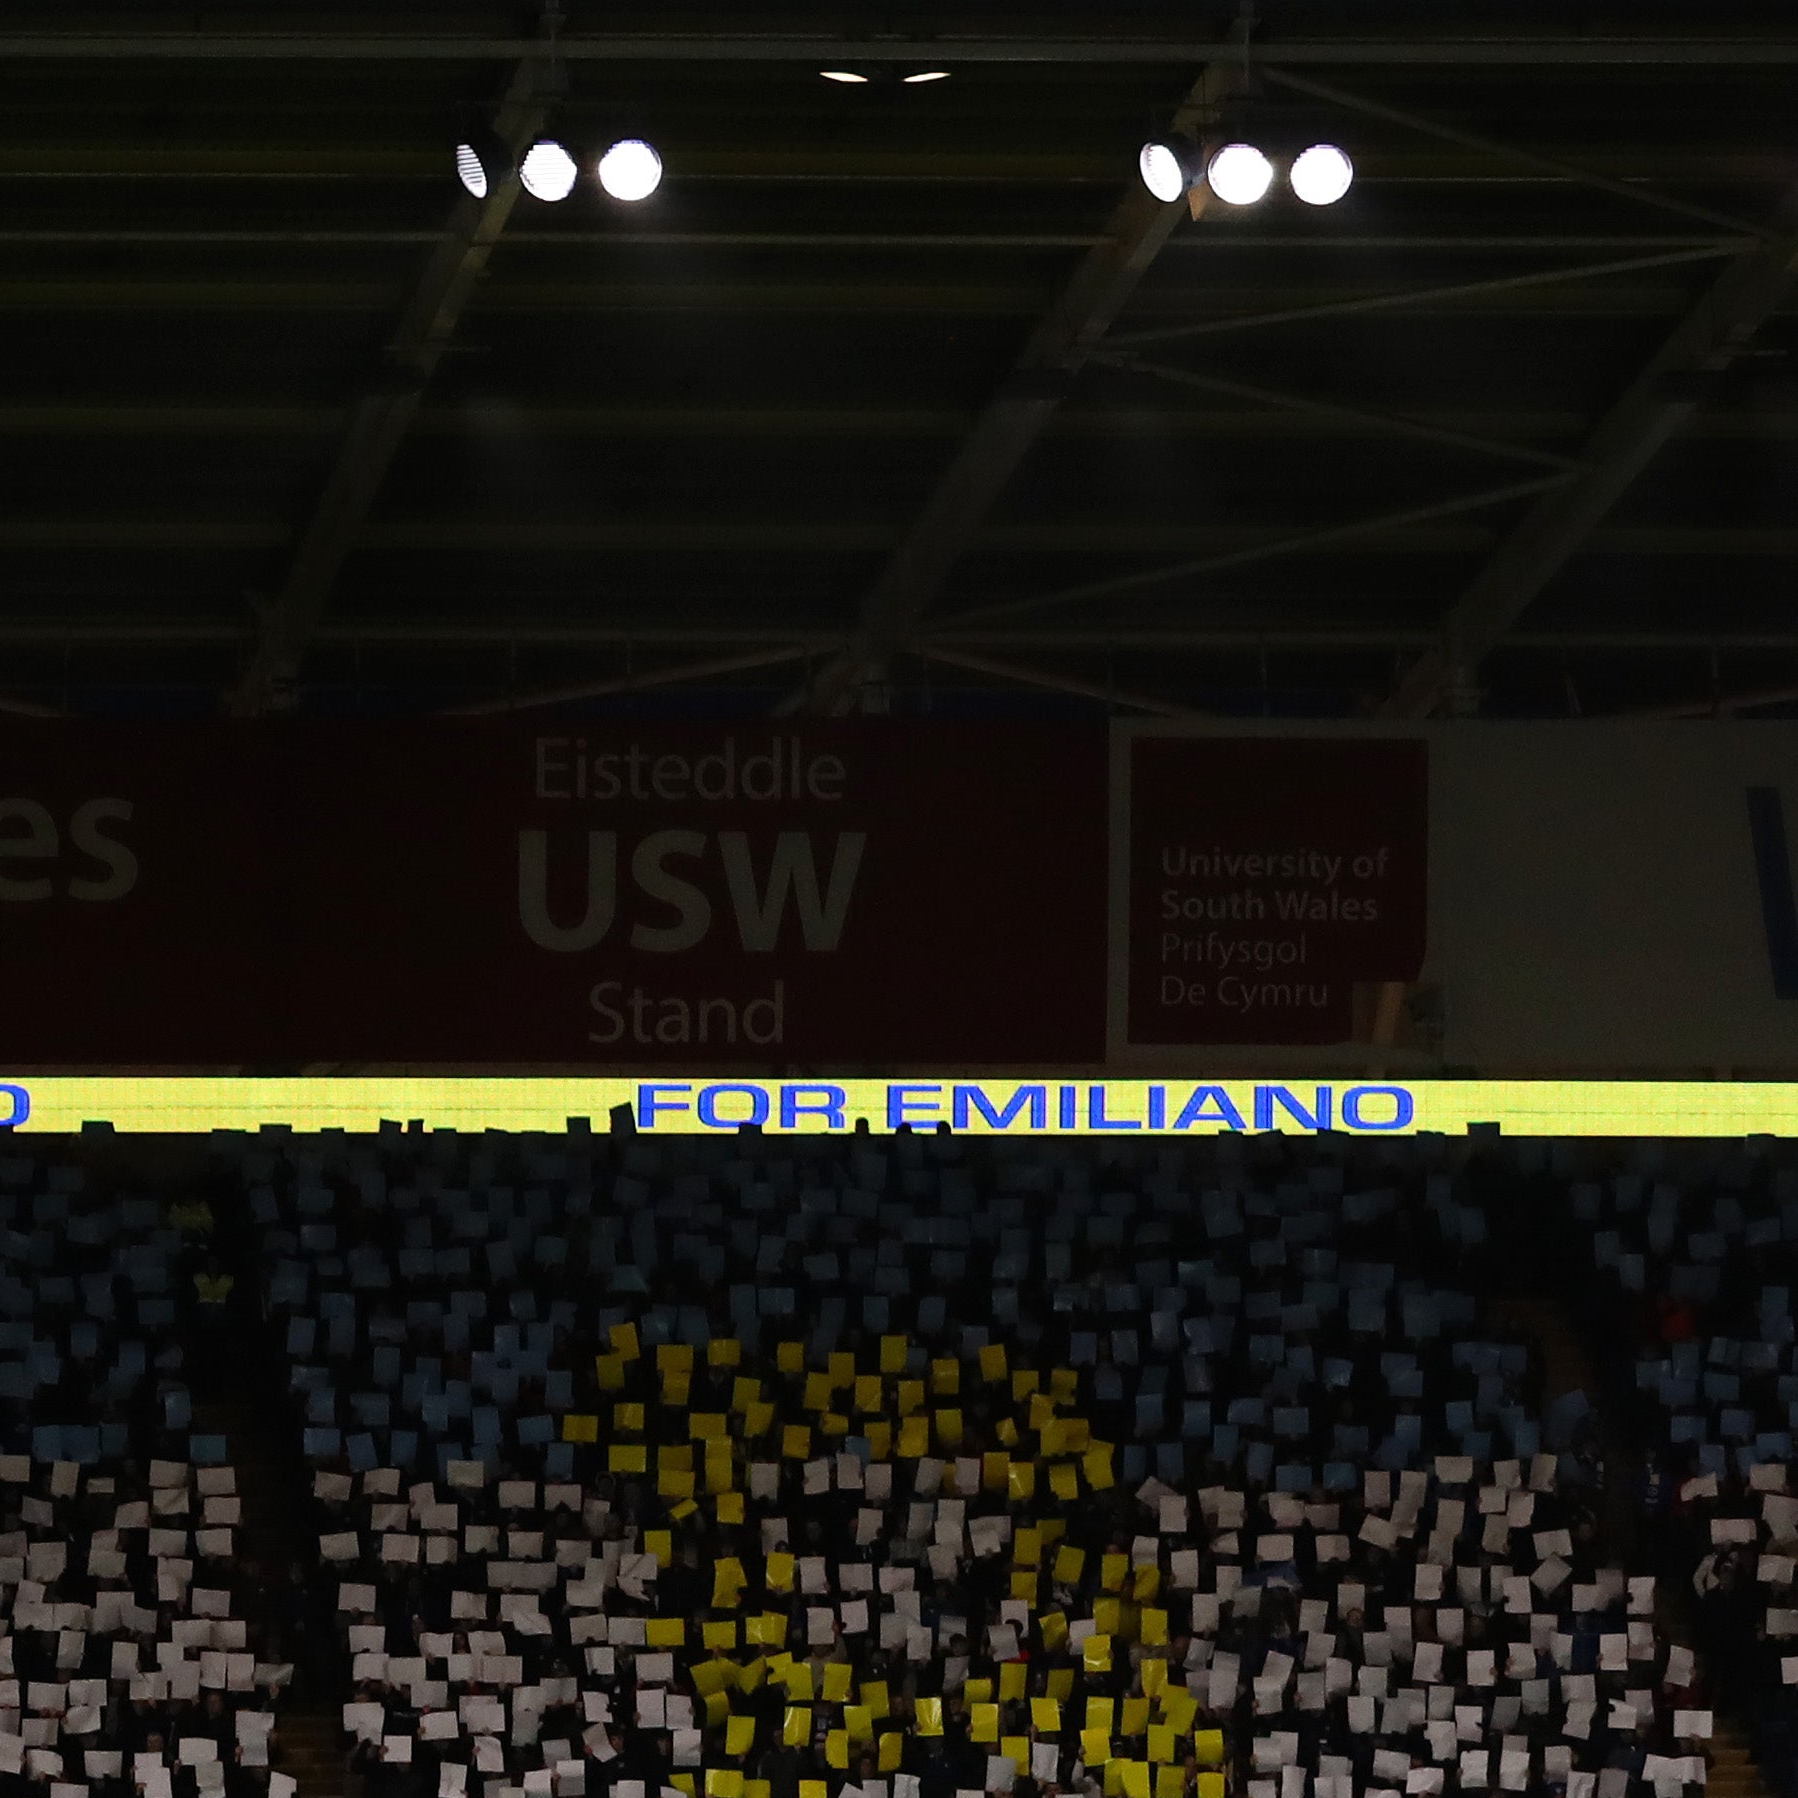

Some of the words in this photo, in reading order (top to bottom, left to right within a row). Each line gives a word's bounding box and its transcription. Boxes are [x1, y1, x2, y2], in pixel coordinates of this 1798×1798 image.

[534, 737, 847, 800] Eisteddle
[1161, 845, 1345, 885] University
[1352, 845, 1390, 880] of
[517, 828, 867, 954] USW
[1161, 890, 1266, 921] South
[1274, 890, 1379, 921] Wales
[1161, 932, 1306, 971] Prifysgol
[588, 979, 785, 1045] Stand
[1160, 976, 1205, 1006] De
[1216, 976, 1329, 1012] Cymru
[638, 1084, 846, 1129] FOR
[887, 1084, 1414, 1130] EMILIANO
